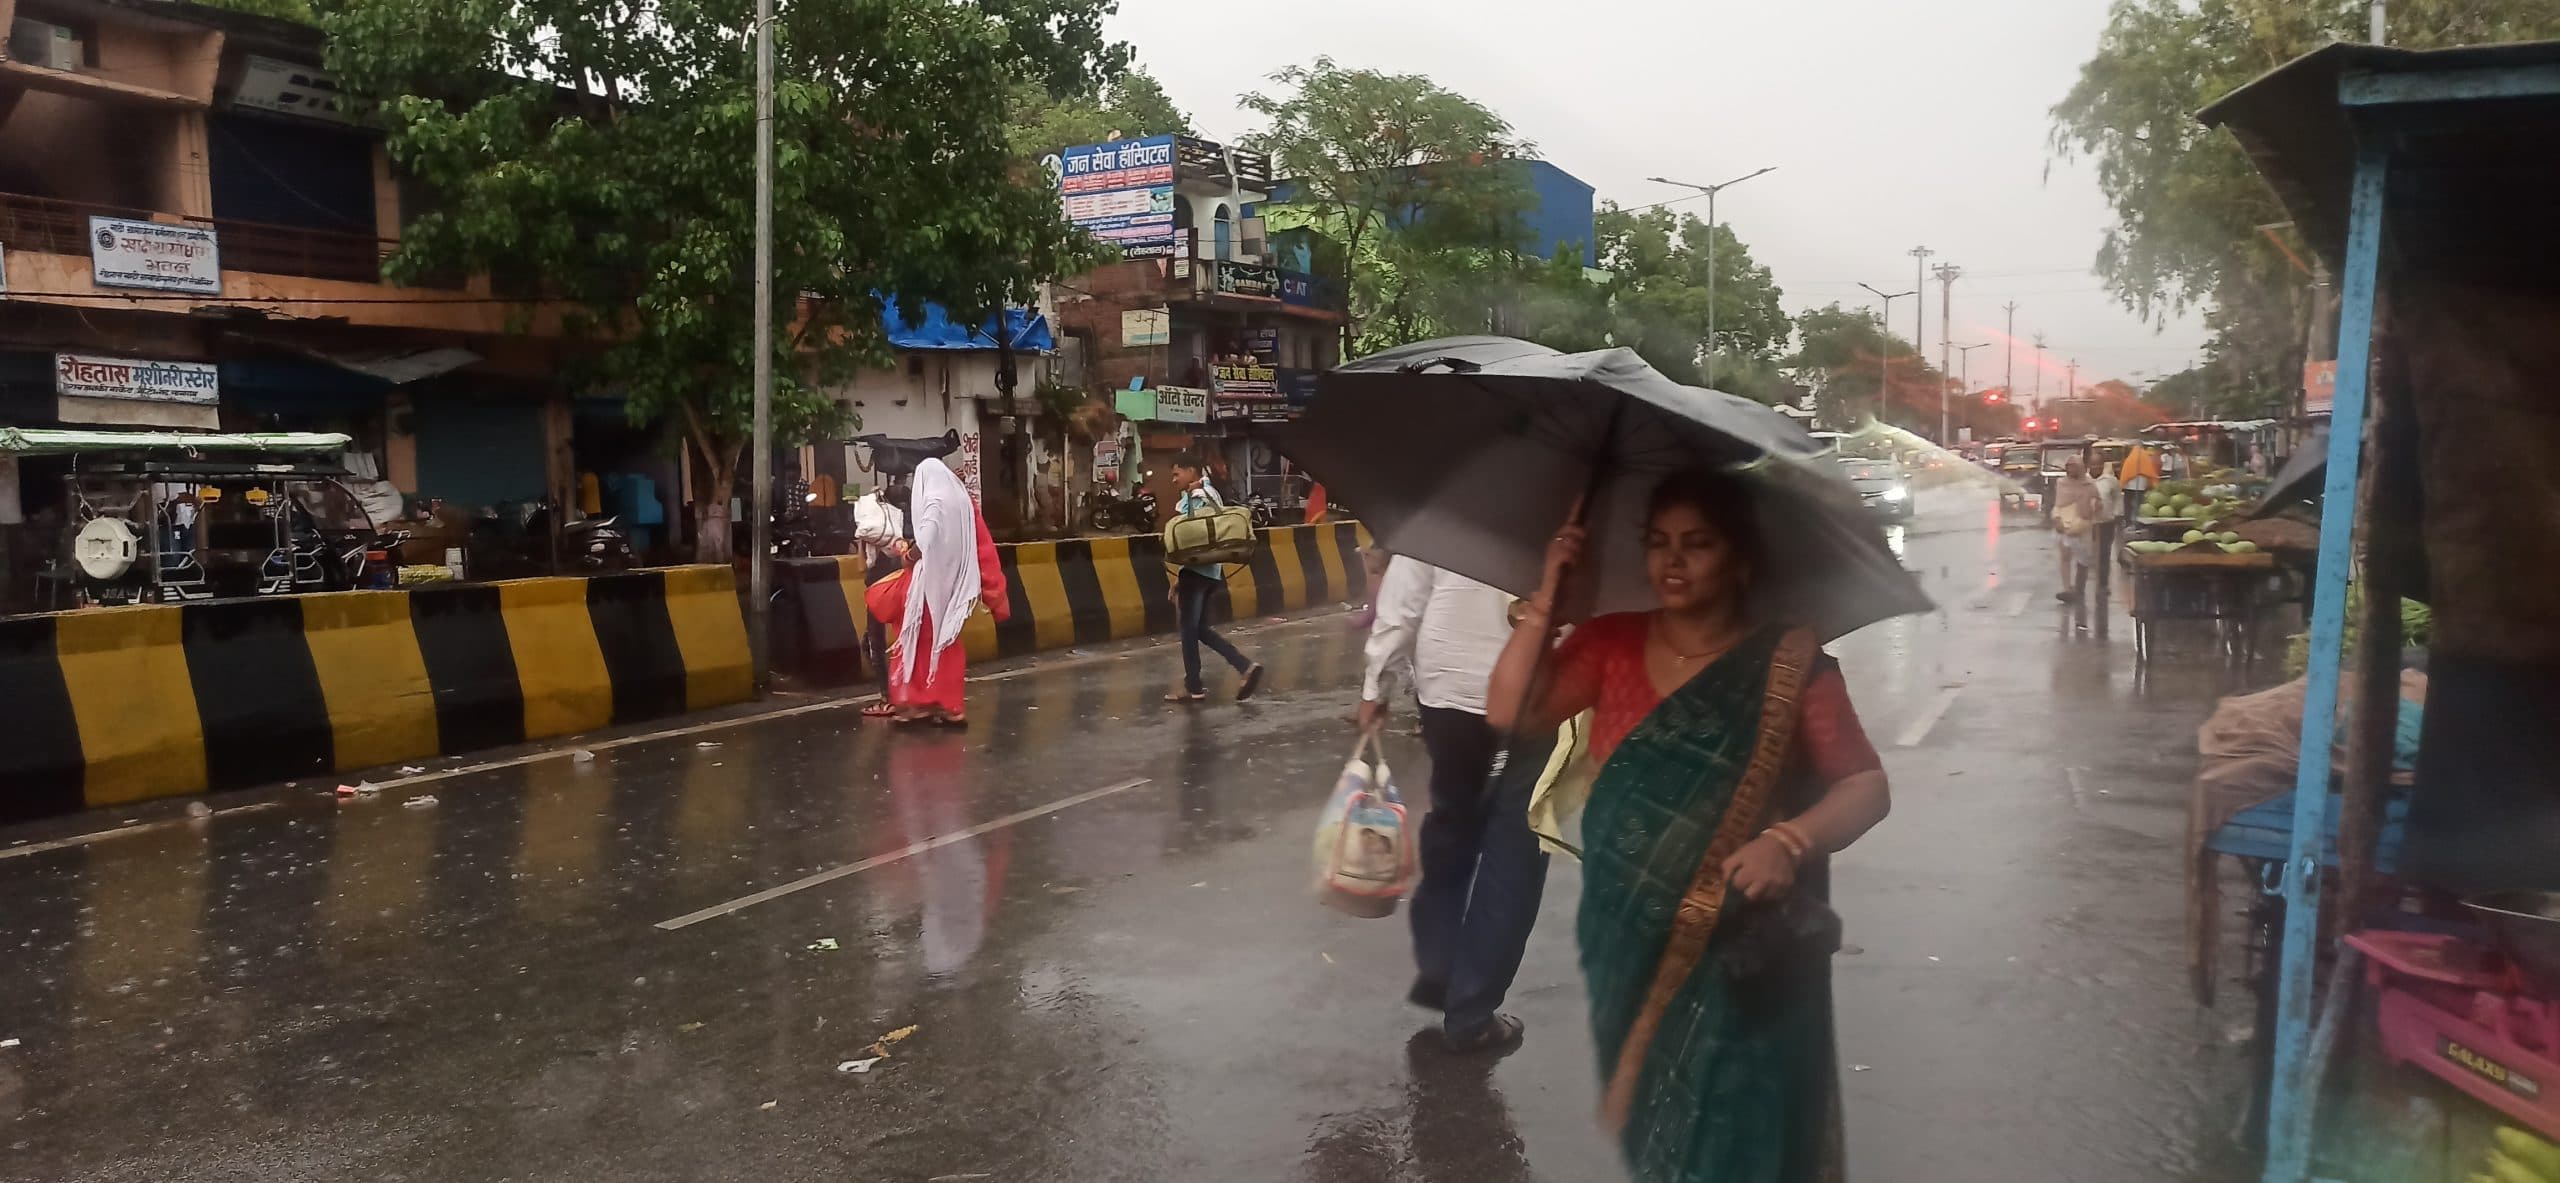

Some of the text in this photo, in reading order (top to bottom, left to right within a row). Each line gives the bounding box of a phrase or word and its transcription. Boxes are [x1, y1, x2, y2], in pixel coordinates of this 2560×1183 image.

[1066, 142, 1171, 174] जन सेवा हॉस्पिटल
[59, 355, 131, 385] रोहतास
[184, 367, 216, 389] स्टोर
[1183, 389, 1205, 408] सेन्टर
